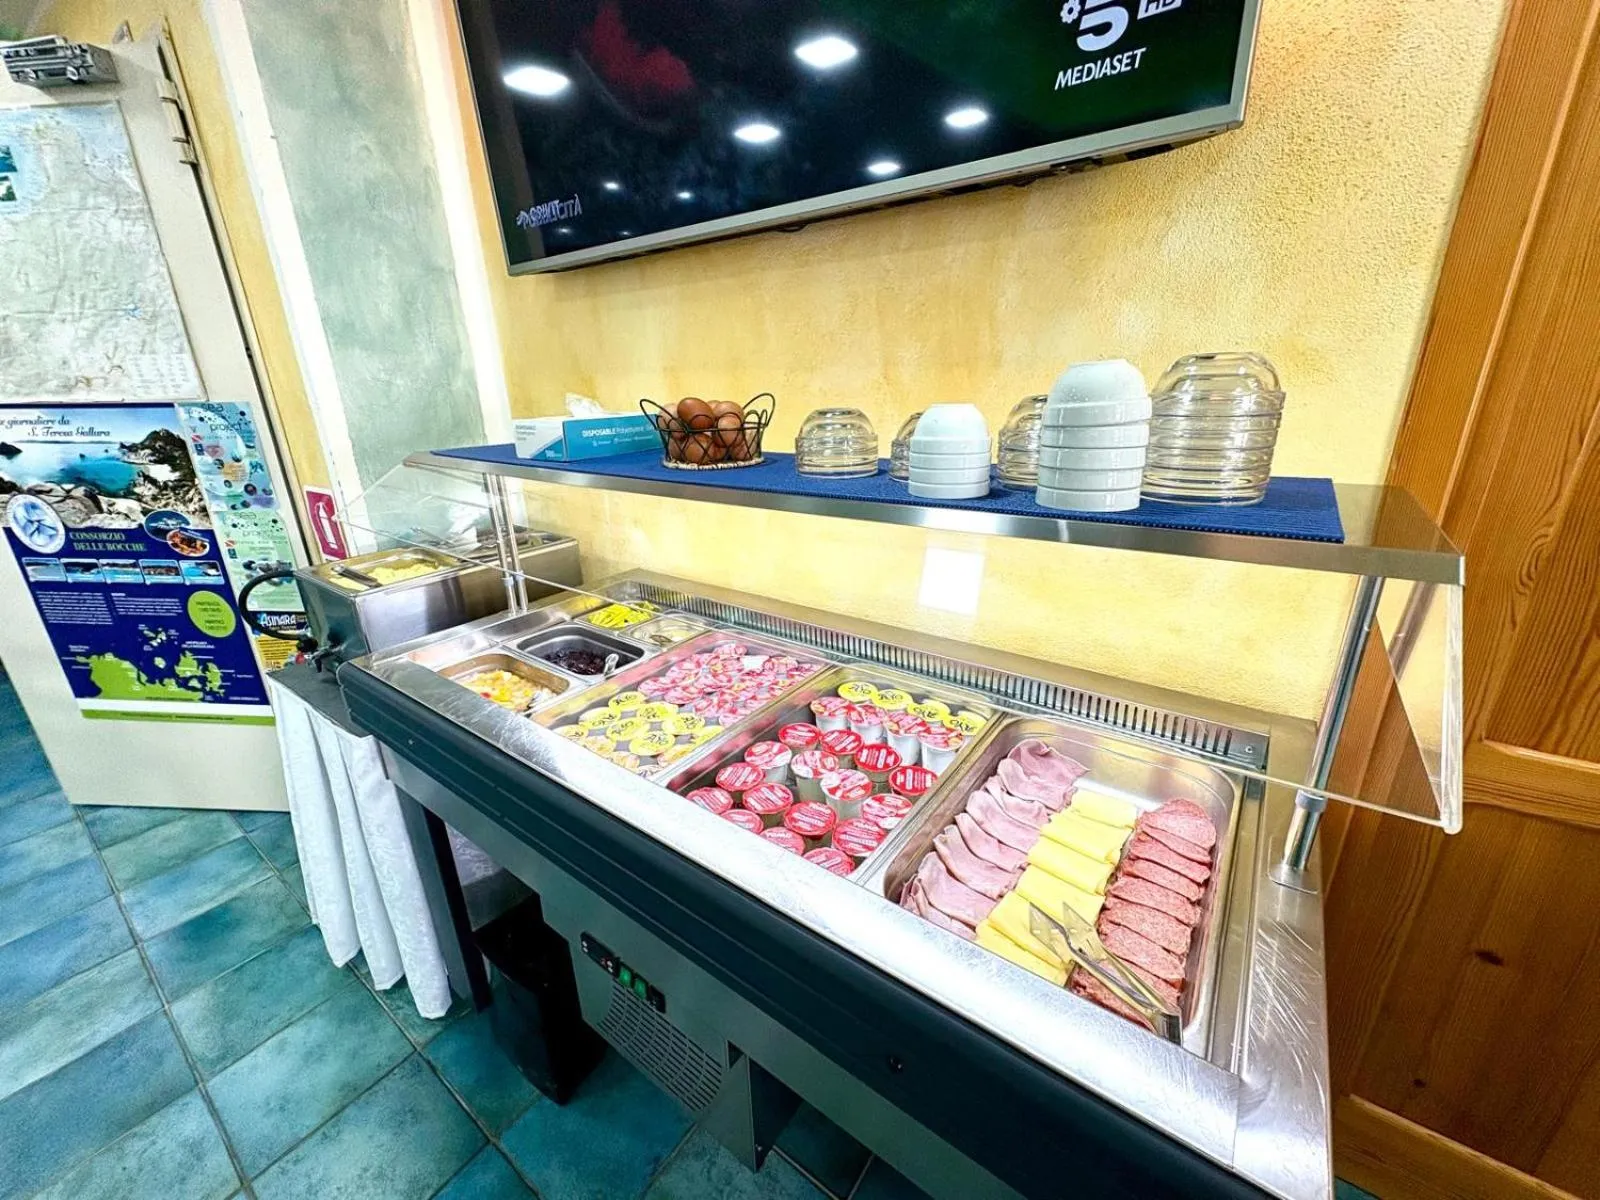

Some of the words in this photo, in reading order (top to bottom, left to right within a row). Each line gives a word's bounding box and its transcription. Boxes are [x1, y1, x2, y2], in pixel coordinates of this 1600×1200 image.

[1076, 0, 1129, 51] 5
[1054, 47, 1147, 91] MEDIASET
[58, 414, 70, 425] da
[582, 428, 616, 438] DISPOSABLE
[69, 530, 125, 541] CONSORZIO
[73, 541, 106, 551] DELLE
[106, 542, 147, 552] BOCCHE
[260, 612, 297, 628] ASINARA
